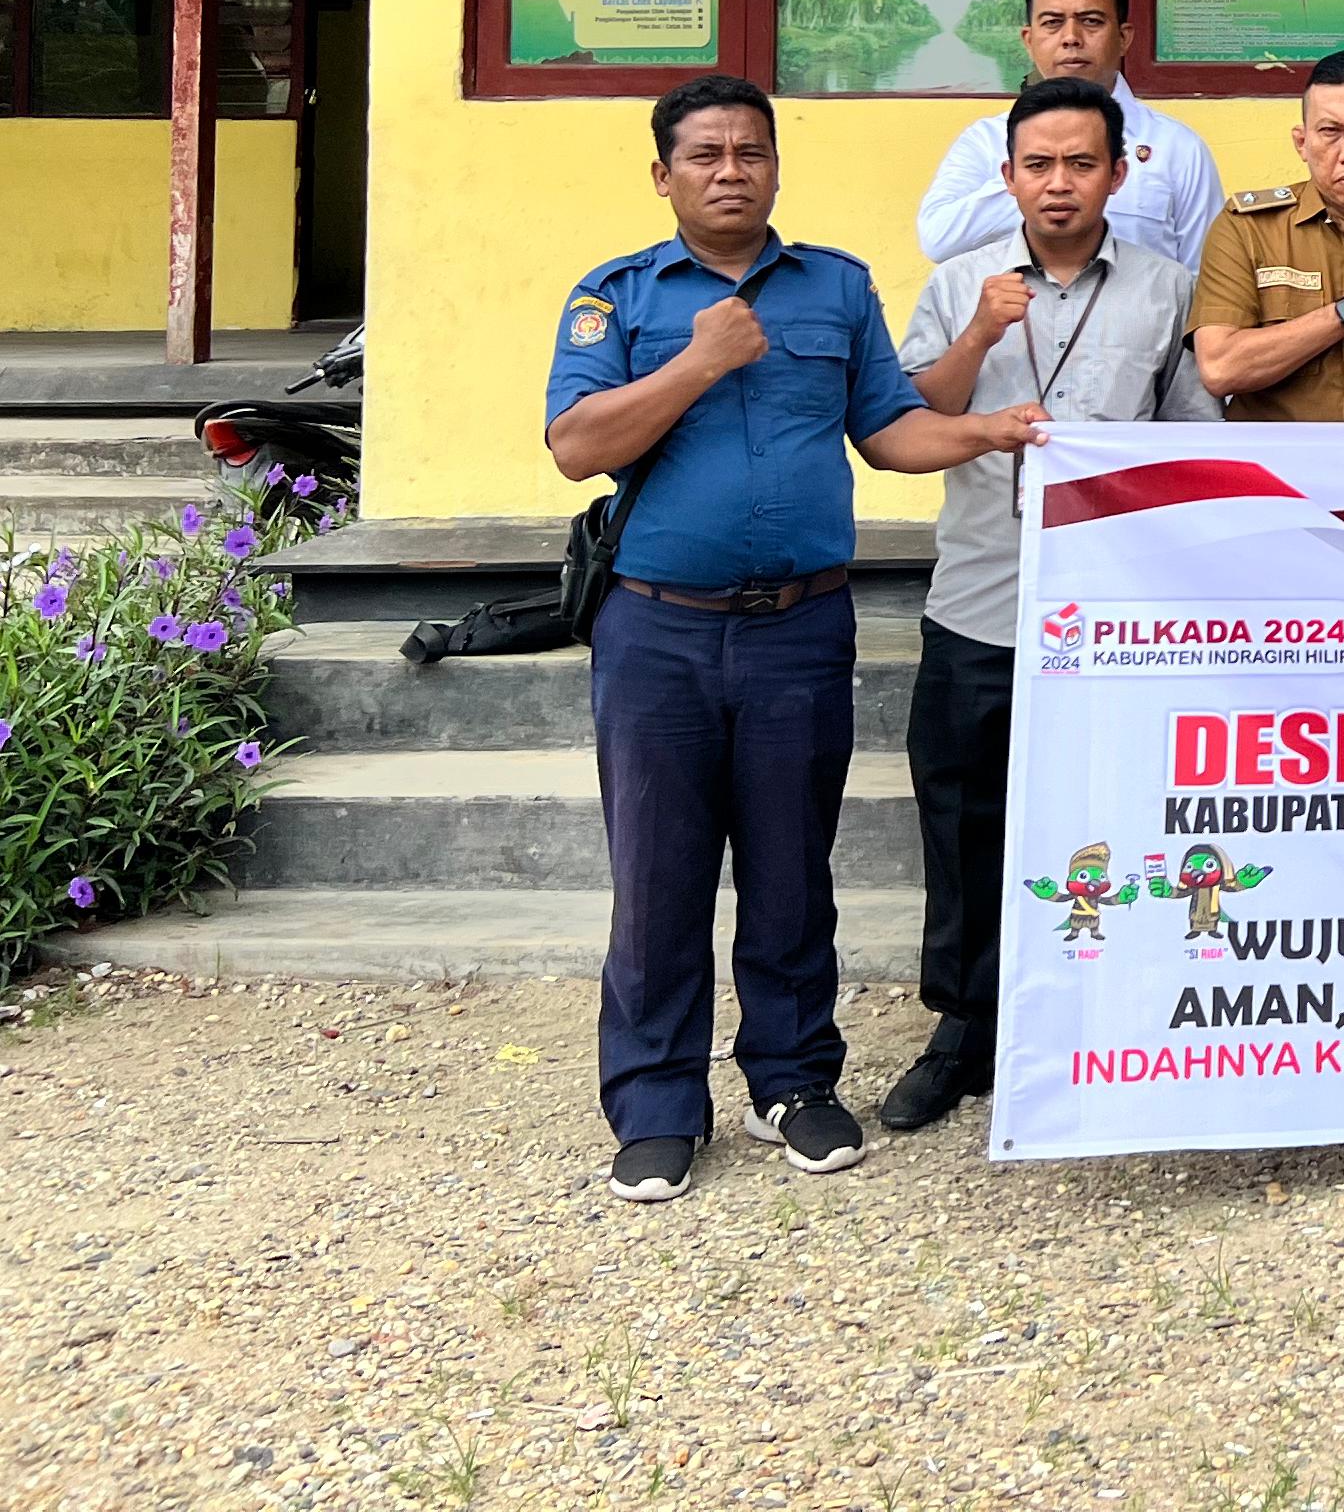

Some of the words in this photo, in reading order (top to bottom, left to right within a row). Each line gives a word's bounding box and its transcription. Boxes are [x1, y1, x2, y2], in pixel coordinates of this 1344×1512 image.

[1094, 620, 1253, 645] PILKADA
[1041, 656, 1081, 671] 2024
[1093, 650, 1203, 666] KABUPATEN
[1208, 649, 1300, 665] INDRAGIRI
[1070, 1041, 1301, 1086] INDAHNYA
